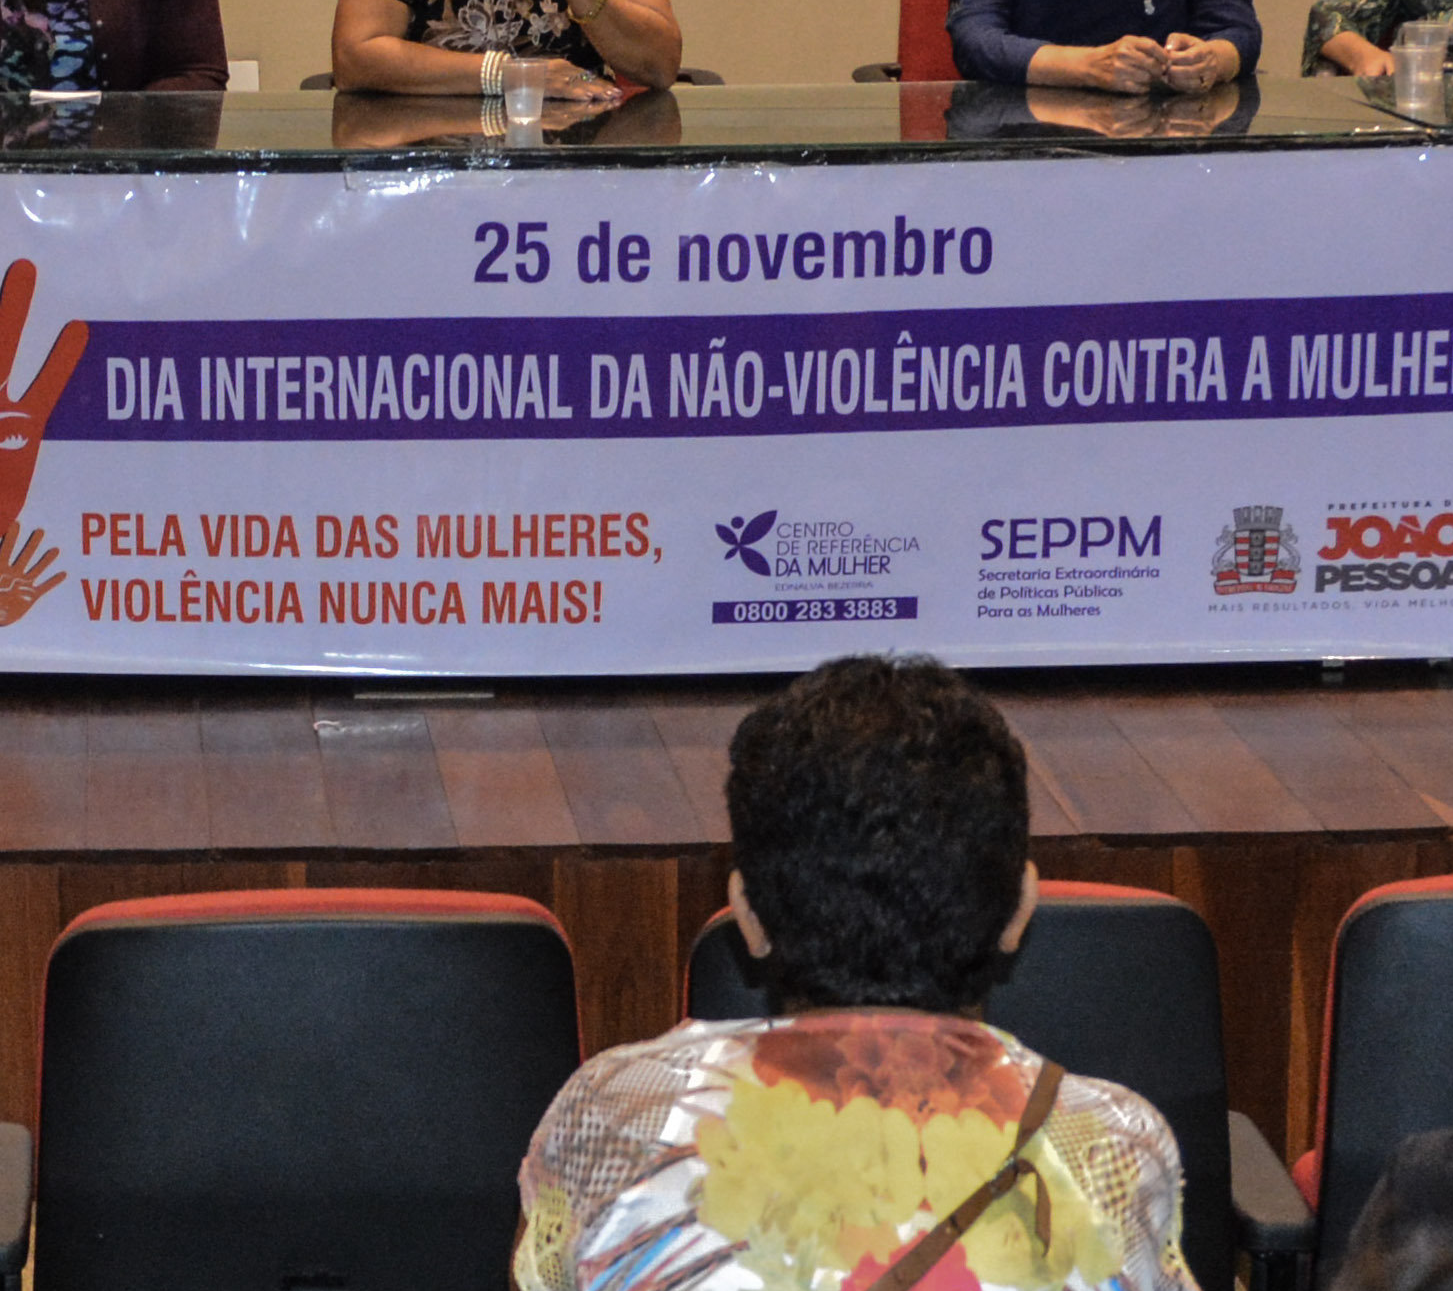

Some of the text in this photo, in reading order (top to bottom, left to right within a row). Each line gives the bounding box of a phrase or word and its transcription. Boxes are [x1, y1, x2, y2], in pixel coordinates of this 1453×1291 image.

[473, 215, 994, 284] 25 de novembro
[106, 356, 184, 421] DIA
[199, 354, 573, 421] INTERNACIONAL
[590, 353, 653, 419] DA
[667, 330, 1027, 418] NÃO-VIOLÊNCIA
[1042, 337, 1228, 408] CONTRA
[1242, 336, 1273, 401] A
[1327, 499, 1433, 510] PREFEITURA
[81, 512, 663, 564] PELA VIDA DAS MULHERES,
[776, 521, 854, 538] CENTRO
[981, 515, 1162, 560] SEPPM
[776, 534, 921, 556] DE REFERÊNCIA
[775, 555, 891, 577] DA MULHER
[978, 565, 1161, 582] Secretaria Extraordinária
[80, 569, 602, 624] VIOLÊNCIA NUNCA MAIS!
[977, 584, 1124, 600] de Políticas Públicas
[733, 599, 898, 621] 0800 283 3883
[977, 603, 1102, 618] Para as Mulheres
[1208, 603, 1244, 613] MAIS
[1364, 599, 1401, 609] VIDA
